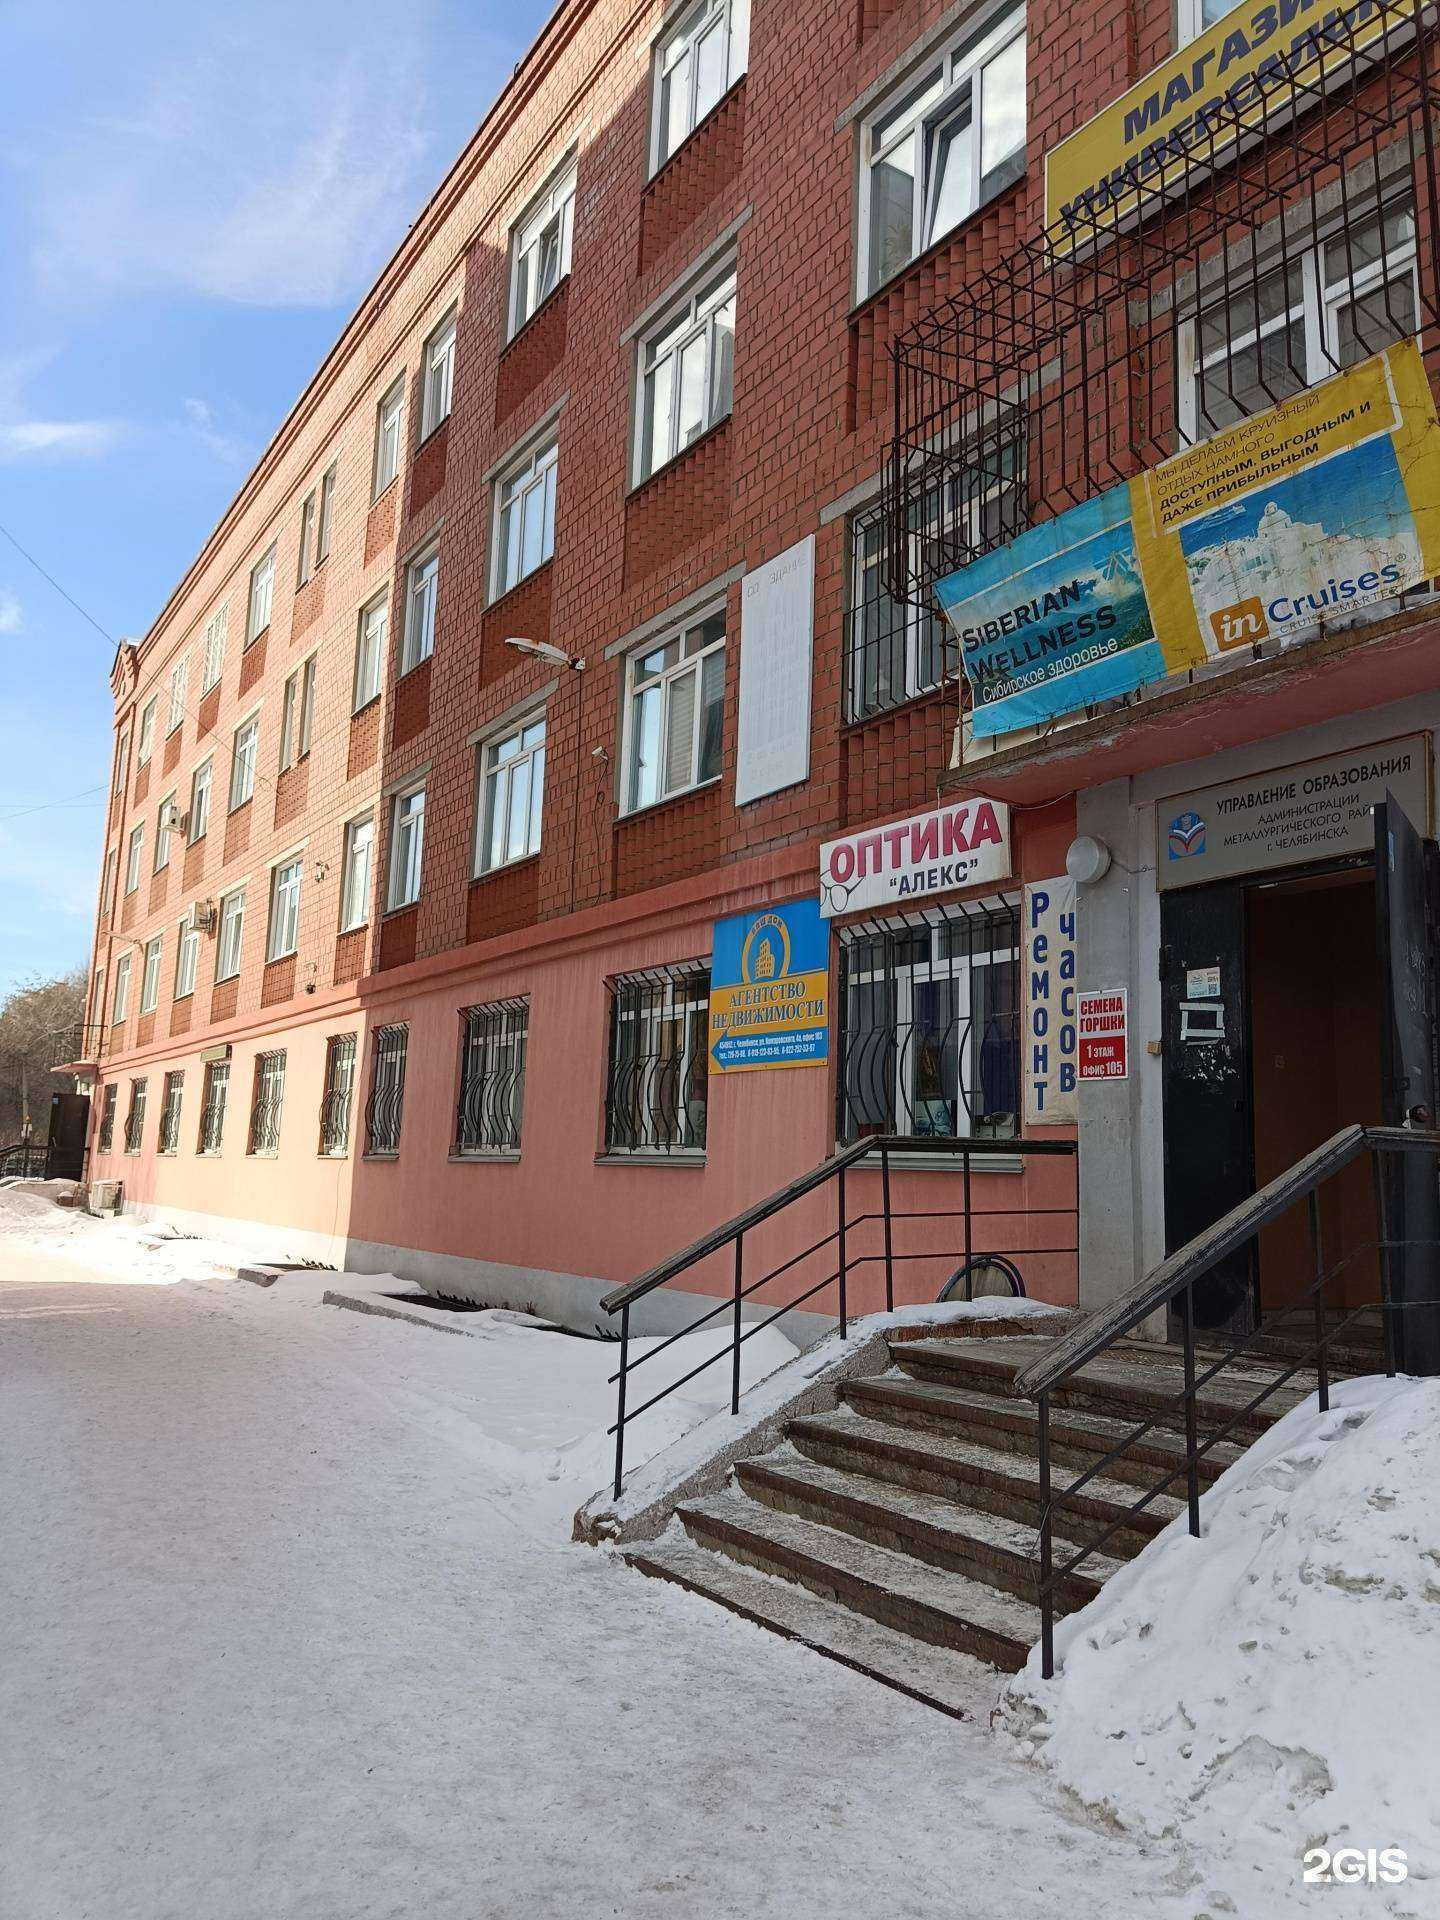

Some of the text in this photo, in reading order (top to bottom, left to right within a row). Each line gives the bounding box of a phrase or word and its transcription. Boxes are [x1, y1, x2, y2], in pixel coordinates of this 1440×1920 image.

[1155, 392, 1320, 482] МЫ ДЕЛАЕМ КРУИЗНЫЙ
[1260, 409, 1355, 461] ВЫГОДНЫМ
[1359, 401, 1371, 414] И
[1157, 432, 1275, 496] ОТДЫХ НАМНОГО
[1162, 443, 1319, 524] ДАЖЕ ПРИБЫЛЬНЫМ
[962, 579, 1081, 653] SIBERIAN
[970, 604, 1117, 682] WELLNESS
[982, 638, 1118, 703] Сибирское здоровье
[1216, 755, 1411, 815] УПРАВЛЕНИЕ ОБРАЗОВАНИЯ
[1224, 813, 1341, 846] МЕТАЛЛУРГИЧЕСКОГО
[1258, 793, 1360, 825] АДМИНИСТРАЦИИ
[829, 801, 1003, 883] ОПТИКА
[1276, 826, 1349, 849] ЧЕЛЯБИНСКА
[712, 999, 825, 1029] НЕДВИЖИМОСТИ
[730, 980, 807, 1008] АГЕНТСТВО
[1080, 997, 1123, 1015] СЕМЕНА
[1080, 1014, 1125, 1032] ГОРШКИ
[1082, 1060, 1123, 1077] ОФИС 105
[1087, 1044, 1114, 1059] 1 ЭТАЖ
